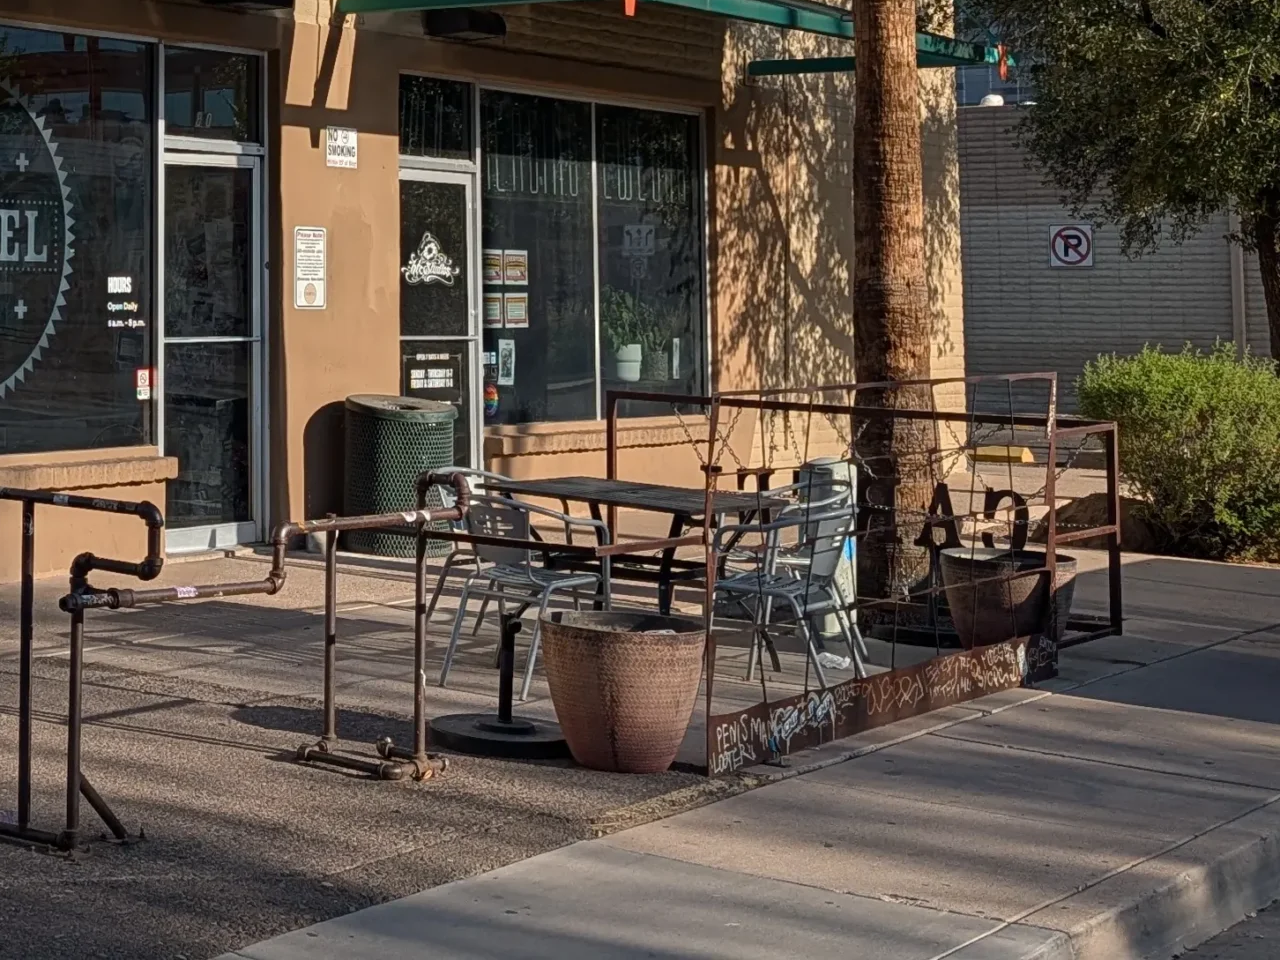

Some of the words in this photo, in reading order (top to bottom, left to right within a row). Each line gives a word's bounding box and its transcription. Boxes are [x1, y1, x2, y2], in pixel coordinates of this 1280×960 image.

[327, 127, 338, 141] NO
[328, 144, 356, 158] SMOKING
[107, 276, 132, 293] HOURS
[716, 713, 748, 752] PENIS
